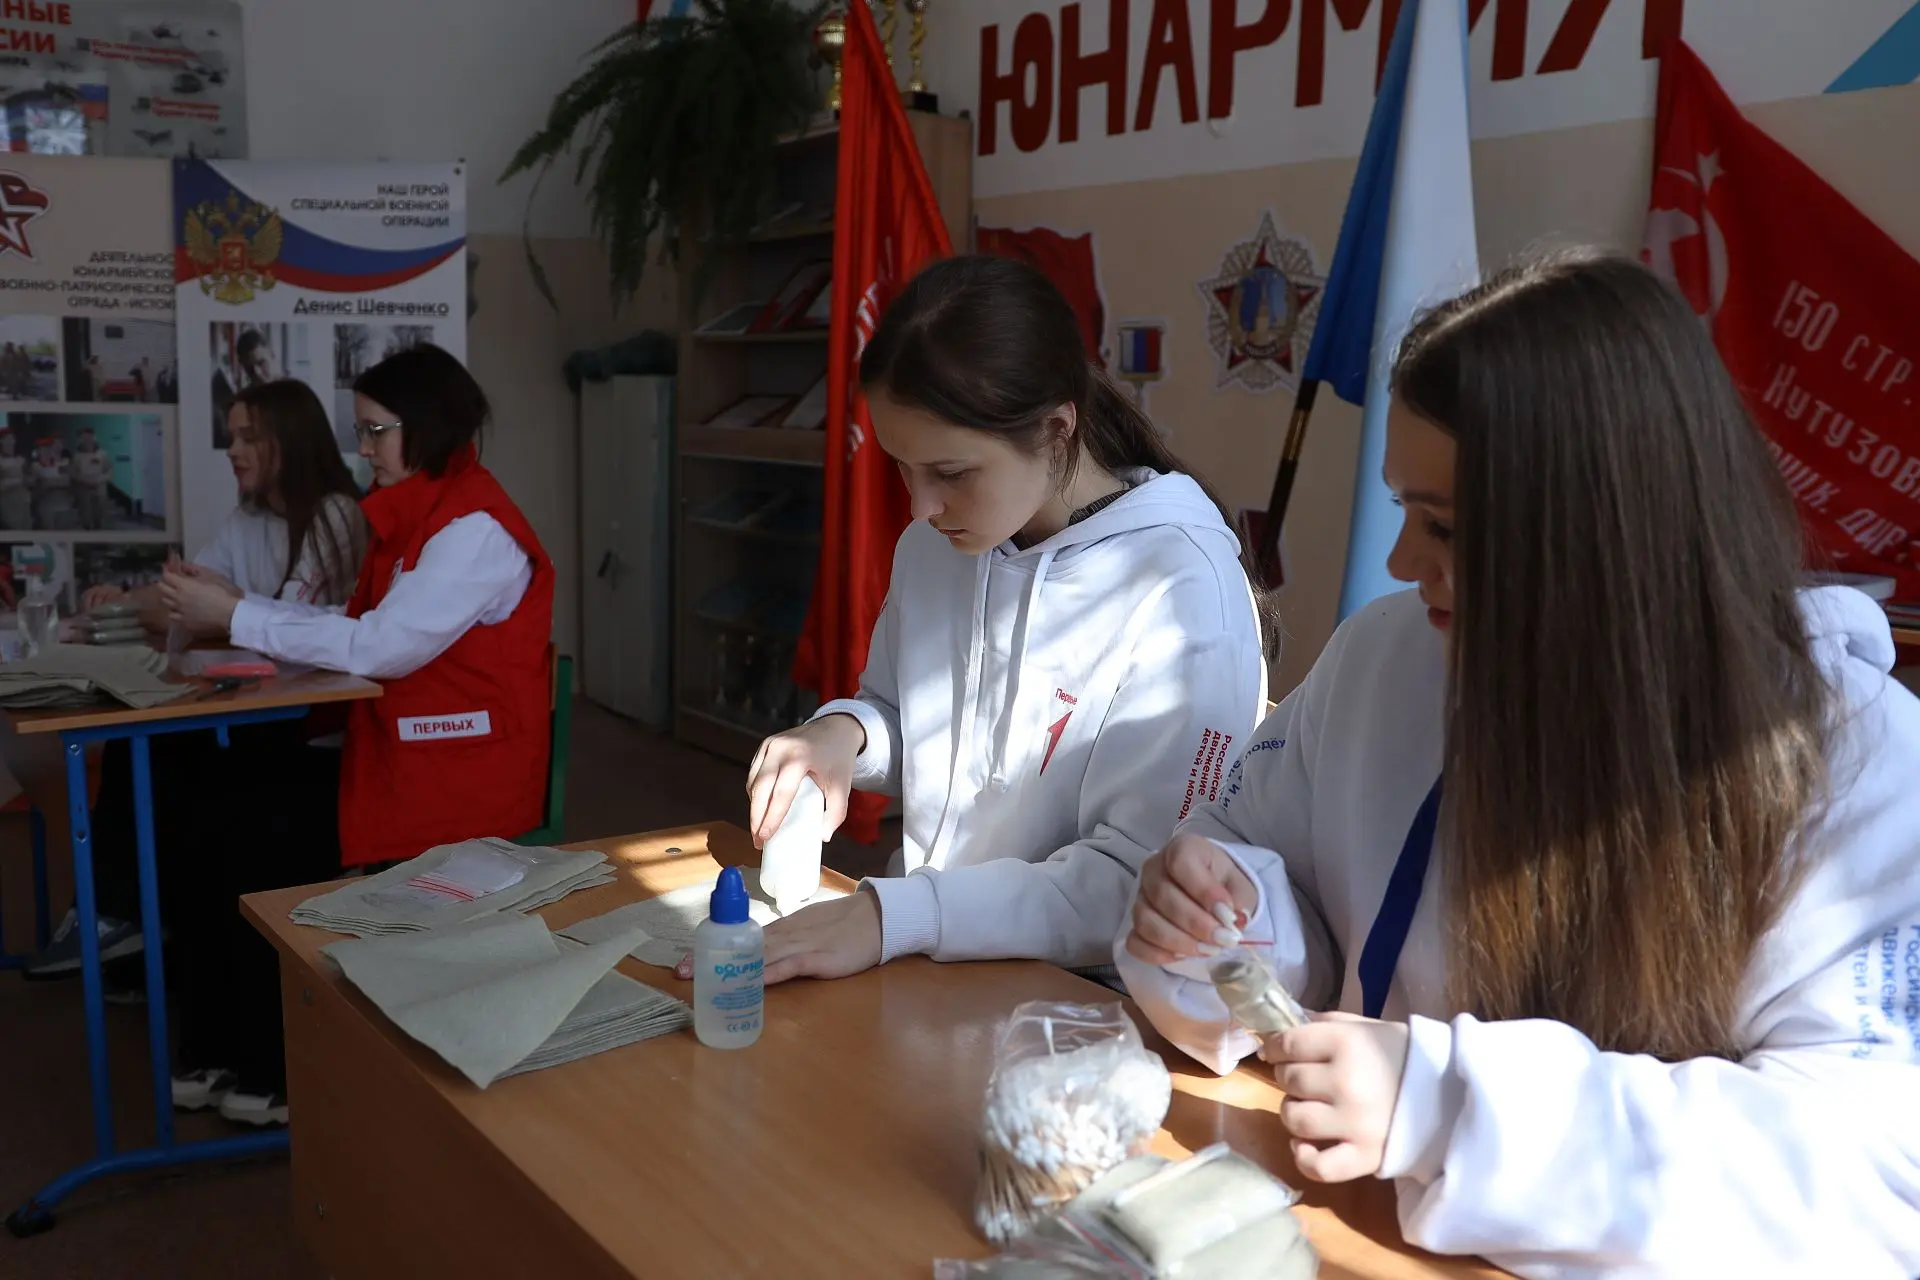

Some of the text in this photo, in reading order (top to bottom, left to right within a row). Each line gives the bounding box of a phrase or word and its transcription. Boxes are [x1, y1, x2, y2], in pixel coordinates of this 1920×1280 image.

[0, 0, 72, 24] НЫЕ
[293, 297, 450, 315] Денис Шевченко
[1772, 279, 1839, 351] 150
[413, 719, 474, 734] ПЕРВЫХ
[1193, 727, 1212, 766] детей
[1190, 768, 1198, 776] и
[1198, 730, 1221, 796] движение
